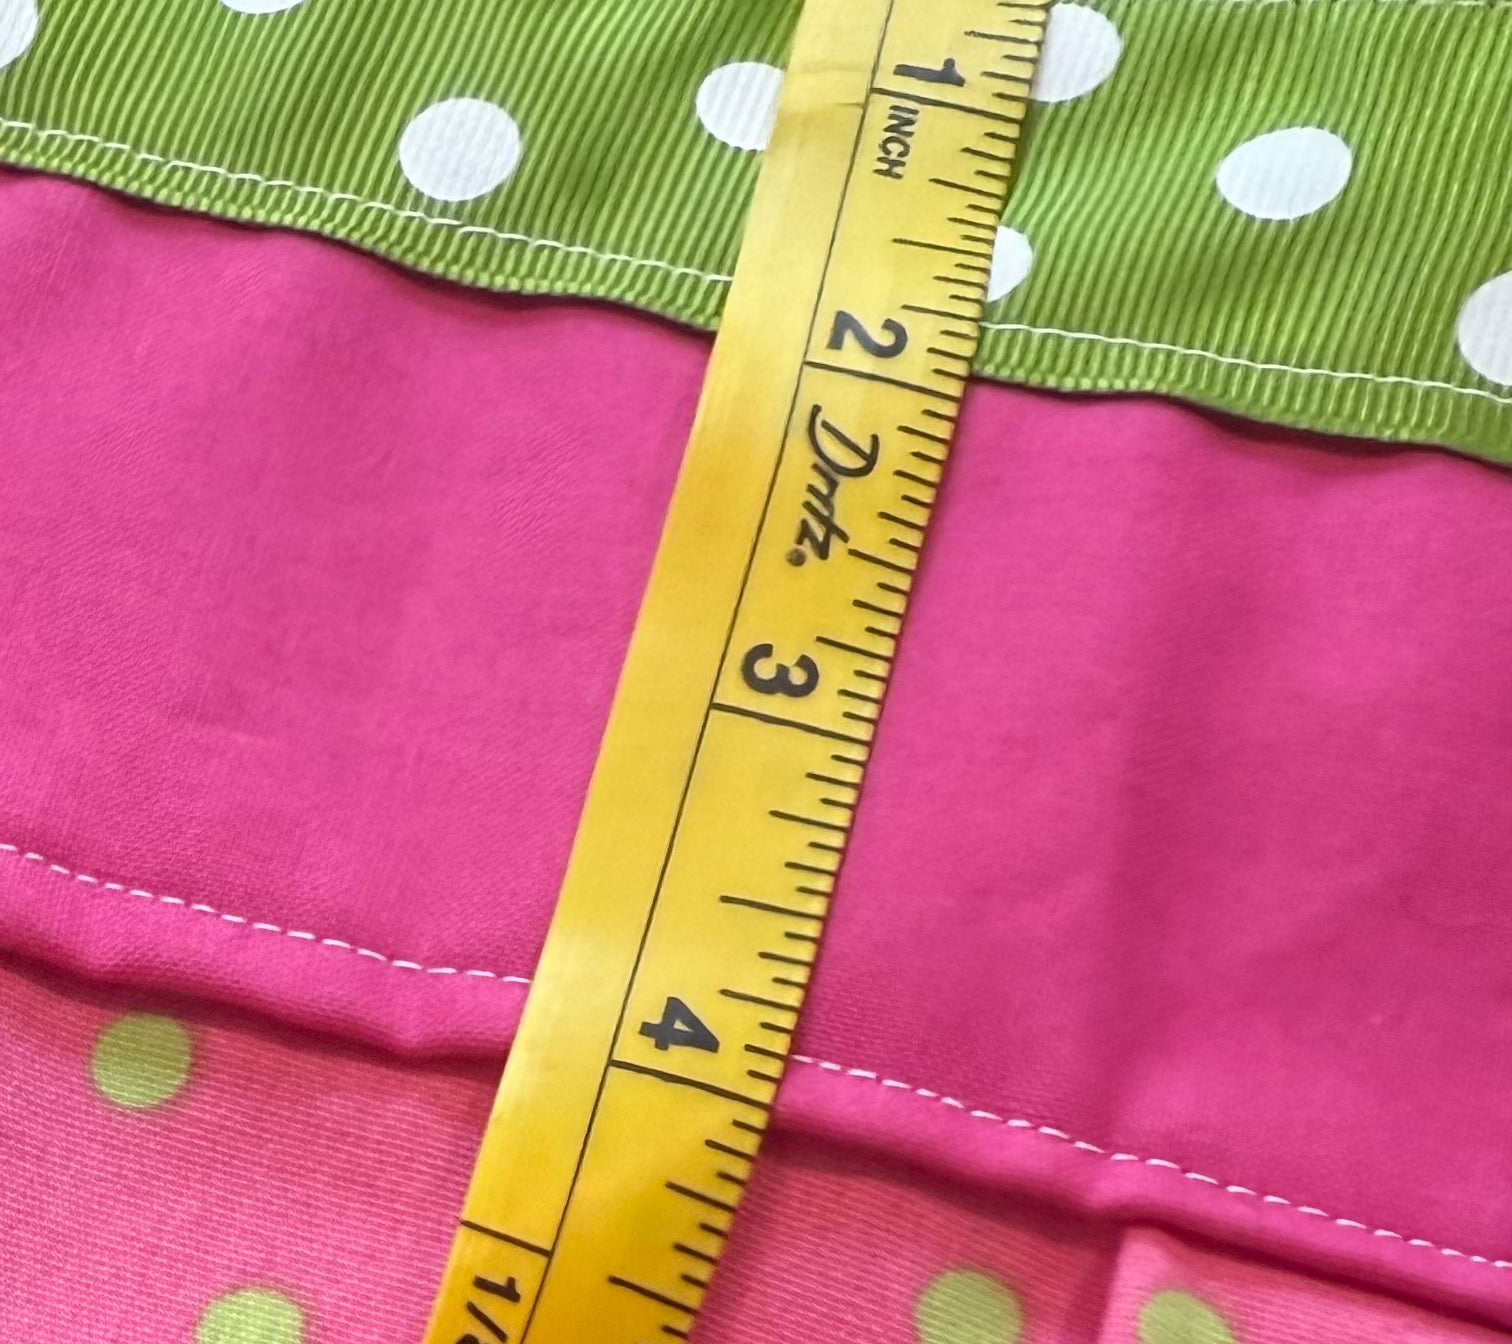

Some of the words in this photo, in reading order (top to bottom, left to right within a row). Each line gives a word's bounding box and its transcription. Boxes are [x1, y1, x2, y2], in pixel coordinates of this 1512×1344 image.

[893, 57, 965, 88] 1
[873, 105, 919, 179] INCH
[826, 310, 907, 359] 2
[742, 644, 819, 698] 3
[638, 997, 719, 1052] 4
